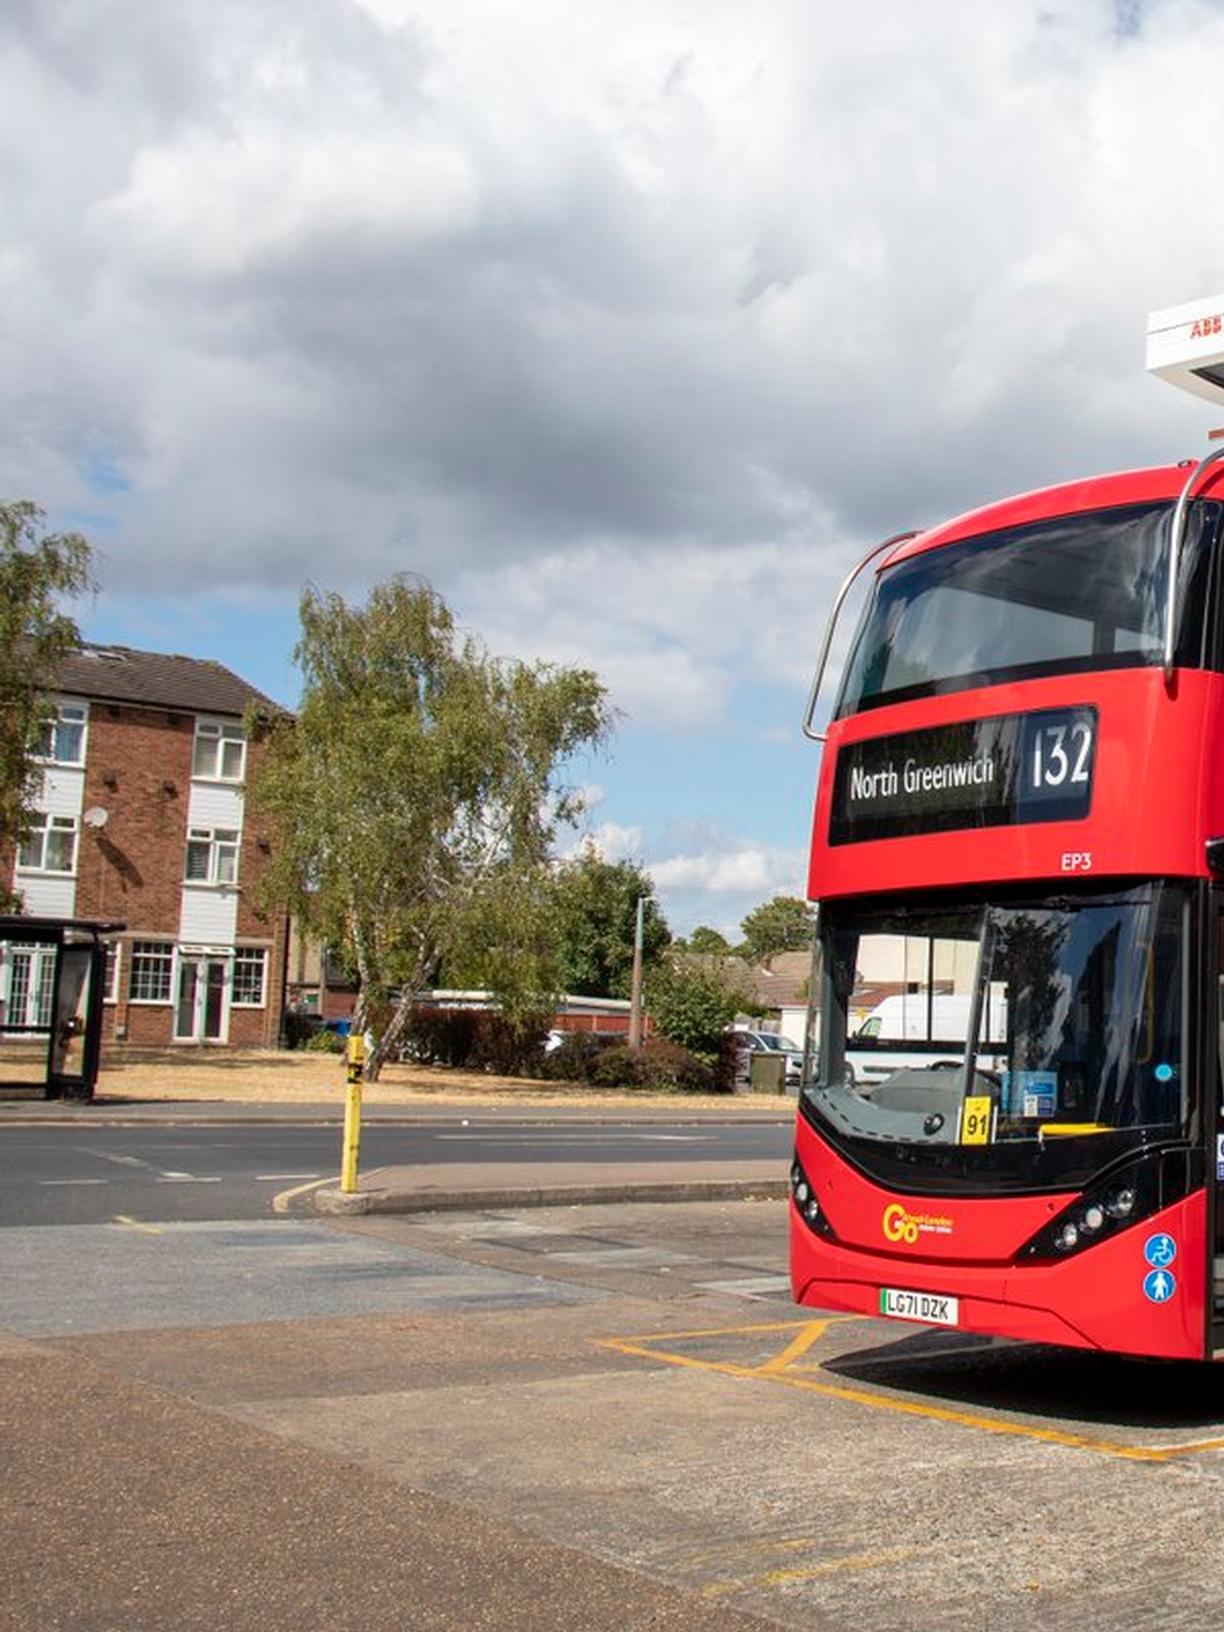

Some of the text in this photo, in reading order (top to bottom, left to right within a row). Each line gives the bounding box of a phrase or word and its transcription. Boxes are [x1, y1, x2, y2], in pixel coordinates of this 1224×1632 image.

[1190, 315, 1221, 339] ABB
[1033, 722, 1092, 787] 132
[851, 756, 994, 800] North Greenwich
[1061, 853, 1092, 870] EP3
[967, 1114, 987, 1136] 91
[883, 1204, 918, 1243] Go
[888, 1292, 948, 1319] LG71 DZK
